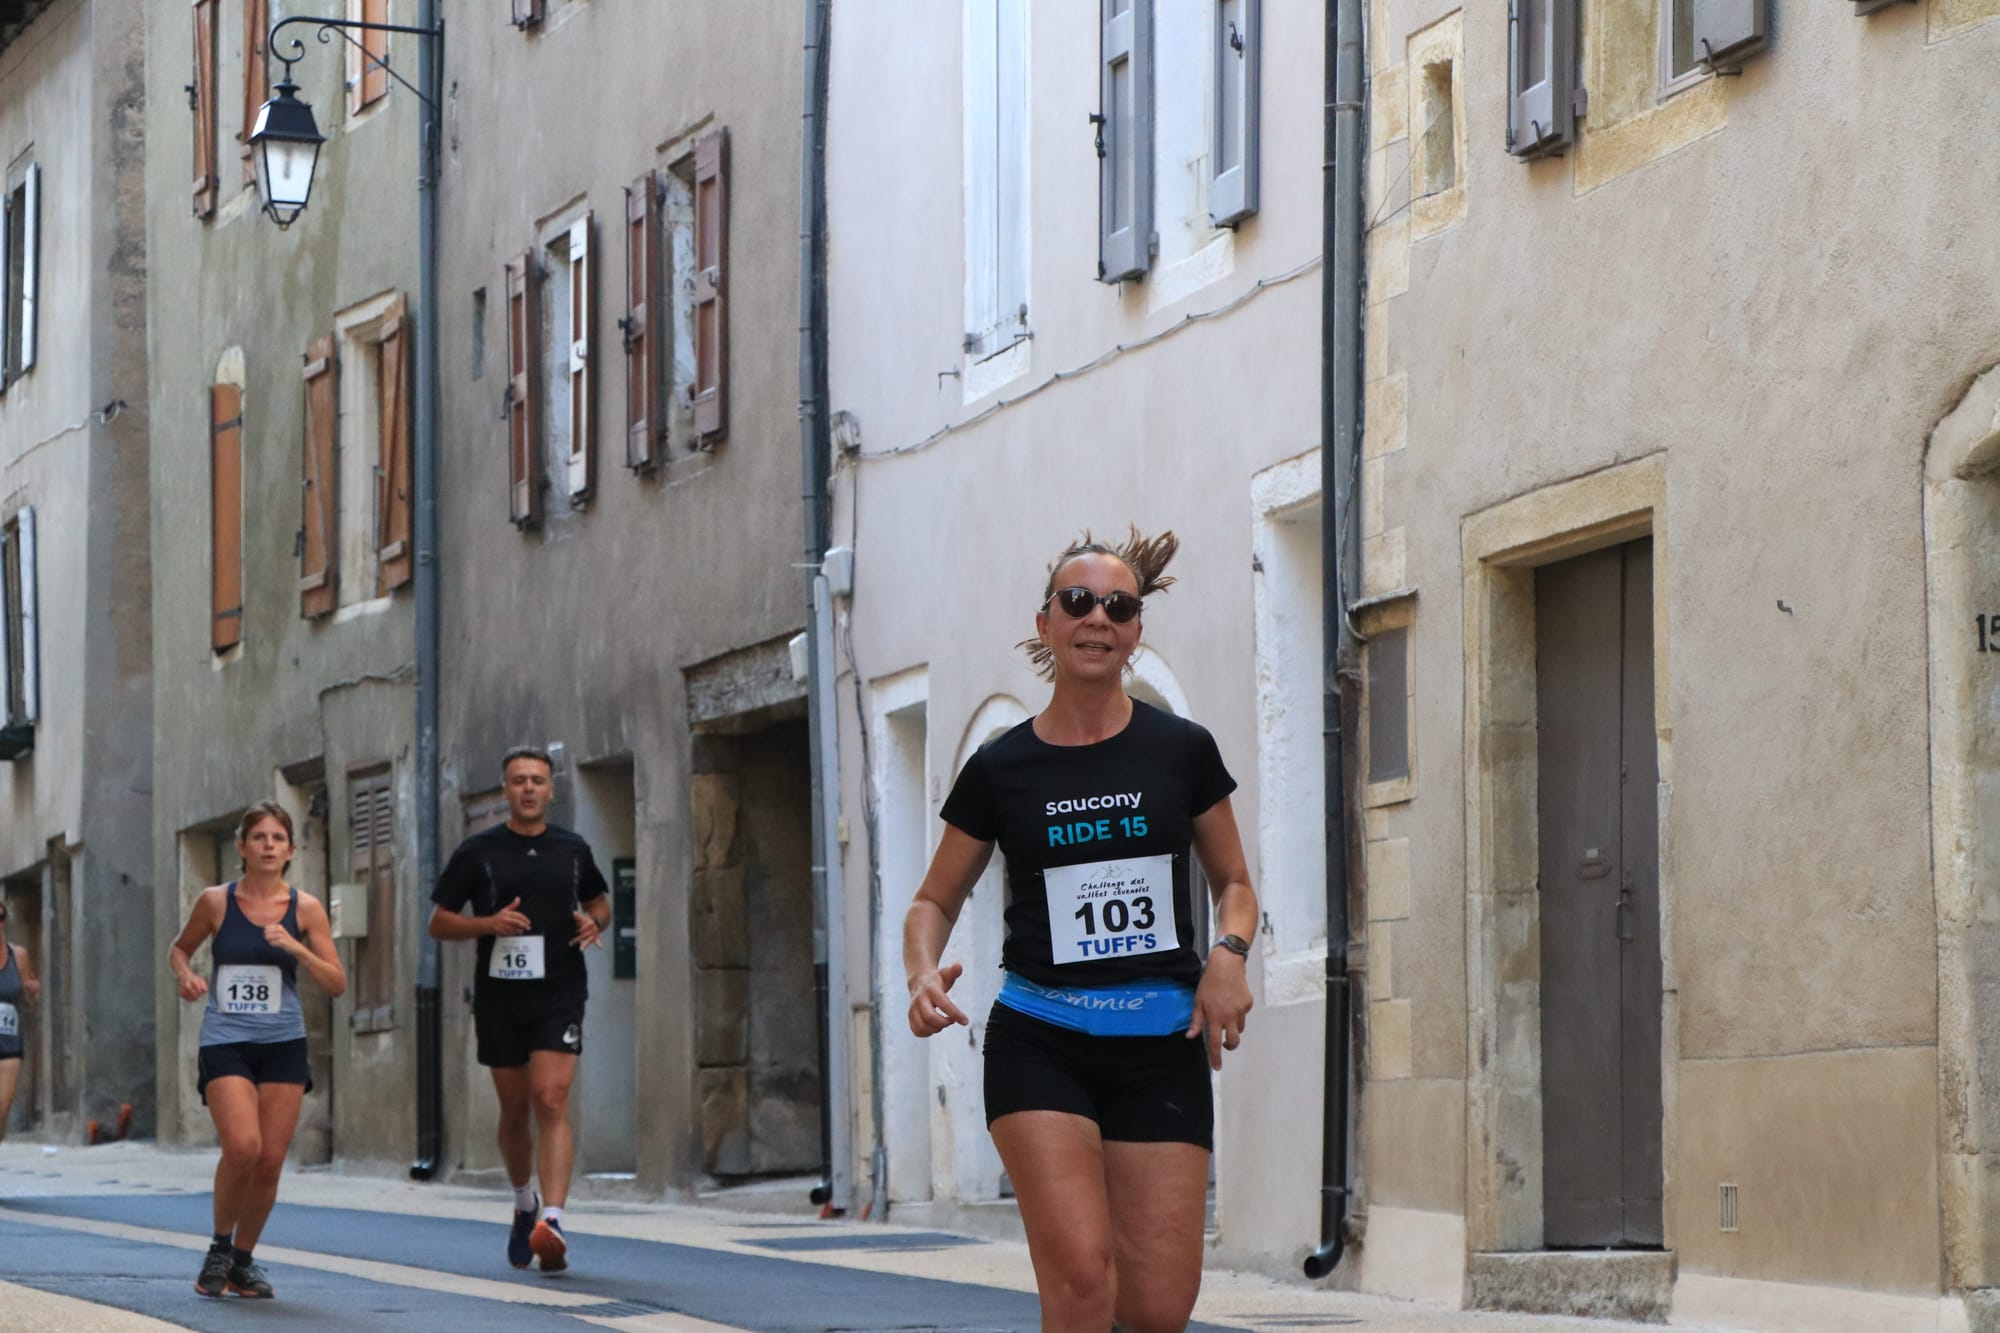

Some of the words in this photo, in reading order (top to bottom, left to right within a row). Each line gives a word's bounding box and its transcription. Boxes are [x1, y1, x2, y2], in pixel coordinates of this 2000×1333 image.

[1975, 614, 2000, 652] 15
[1045, 791, 1142, 816] saucony
[1048, 819, 1112, 847] RIDE
[1119, 816, 1149, 838] 15
[1080, 881, 1125, 891] Challenge
[1130, 878, 1145, 886] des
[1076, 890, 1107, 900] vallées
[1075, 896, 1156, 935] 103
[1077, 933, 1157, 957] TUFF'S
[502, 953, 527, 968] 16
[227, 984, 269, 1001] 138
[226, 1002, 268, 1011] TUFF'S
